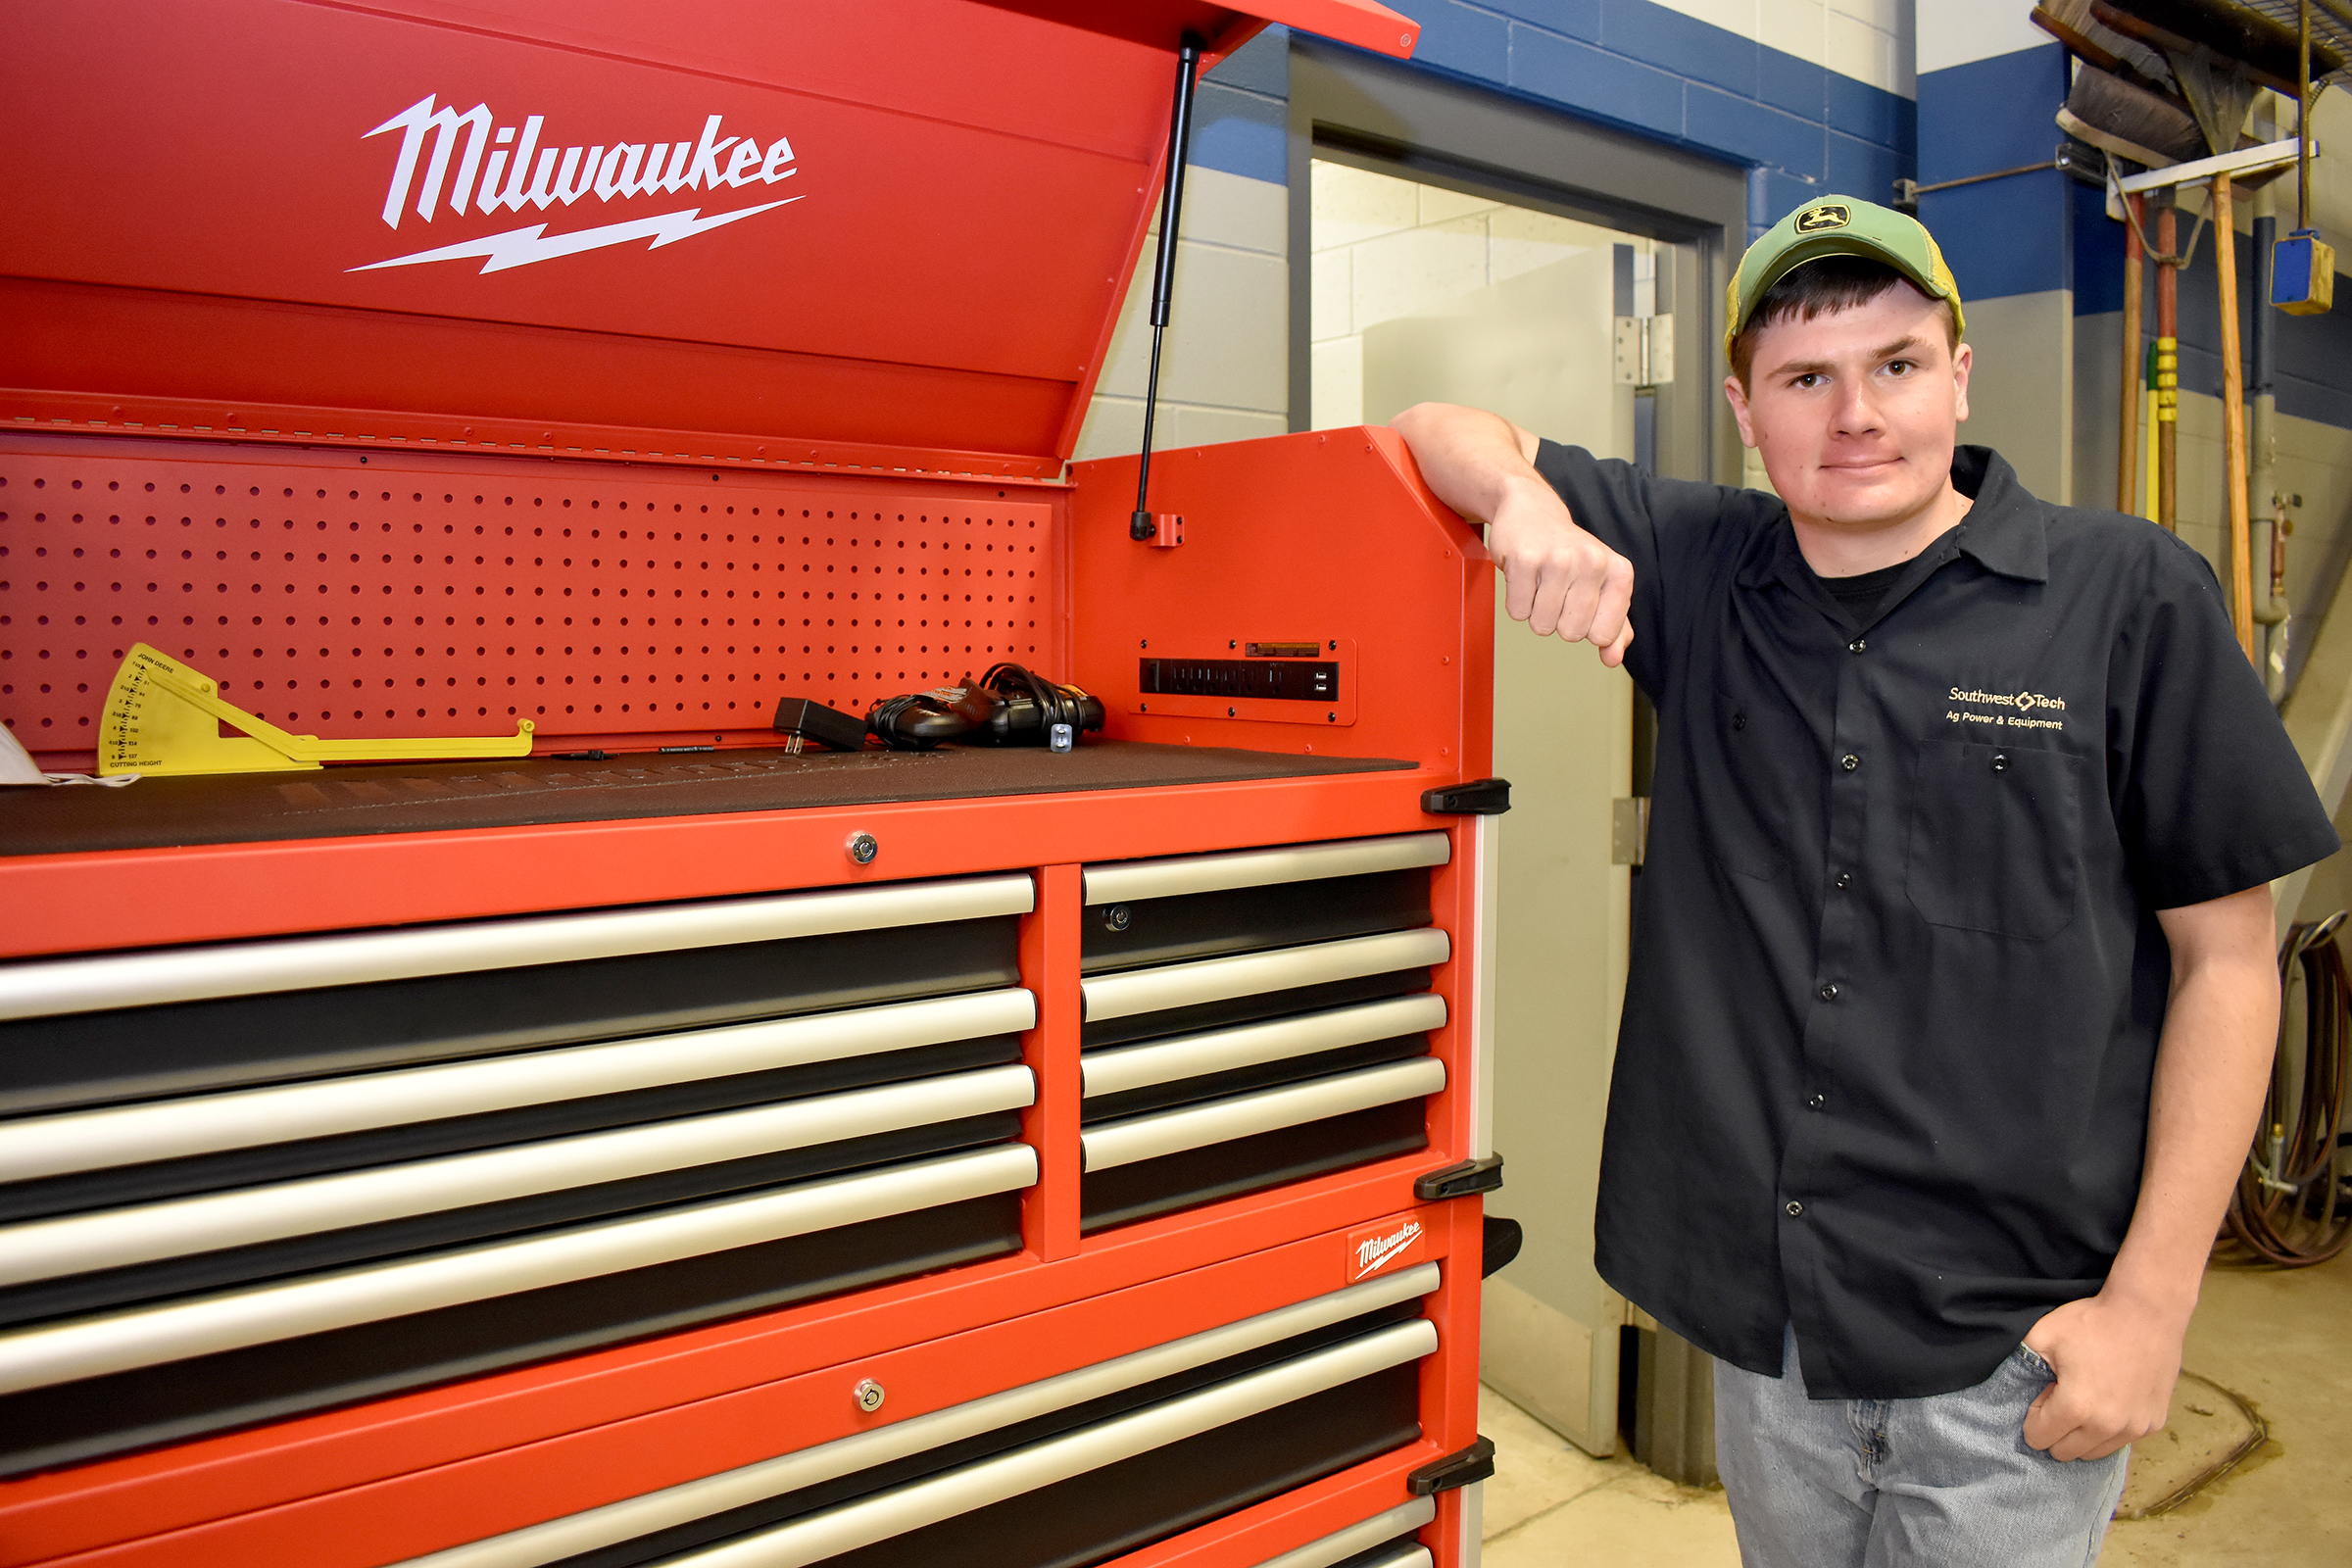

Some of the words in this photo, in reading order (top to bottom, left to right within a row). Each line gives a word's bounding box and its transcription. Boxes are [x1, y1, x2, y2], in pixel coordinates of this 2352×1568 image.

[361, 93, 797, 230] Milwaukee
[138, 653, 155, 663] JOHN
[154, 661, 174, 673] DEERE
[1948, 687, 2015, 706] Southwest
[2034, 694, 2065, 710] Tech
[1945, 710, 1960, 722] Ag
[1962, 711, 1994, 723] Power
[1996, 715, 2004, 724] &
[2008, 716, 2063, 730] Equipment
[1355, 1221, 1420, 1268] Milwaukee
